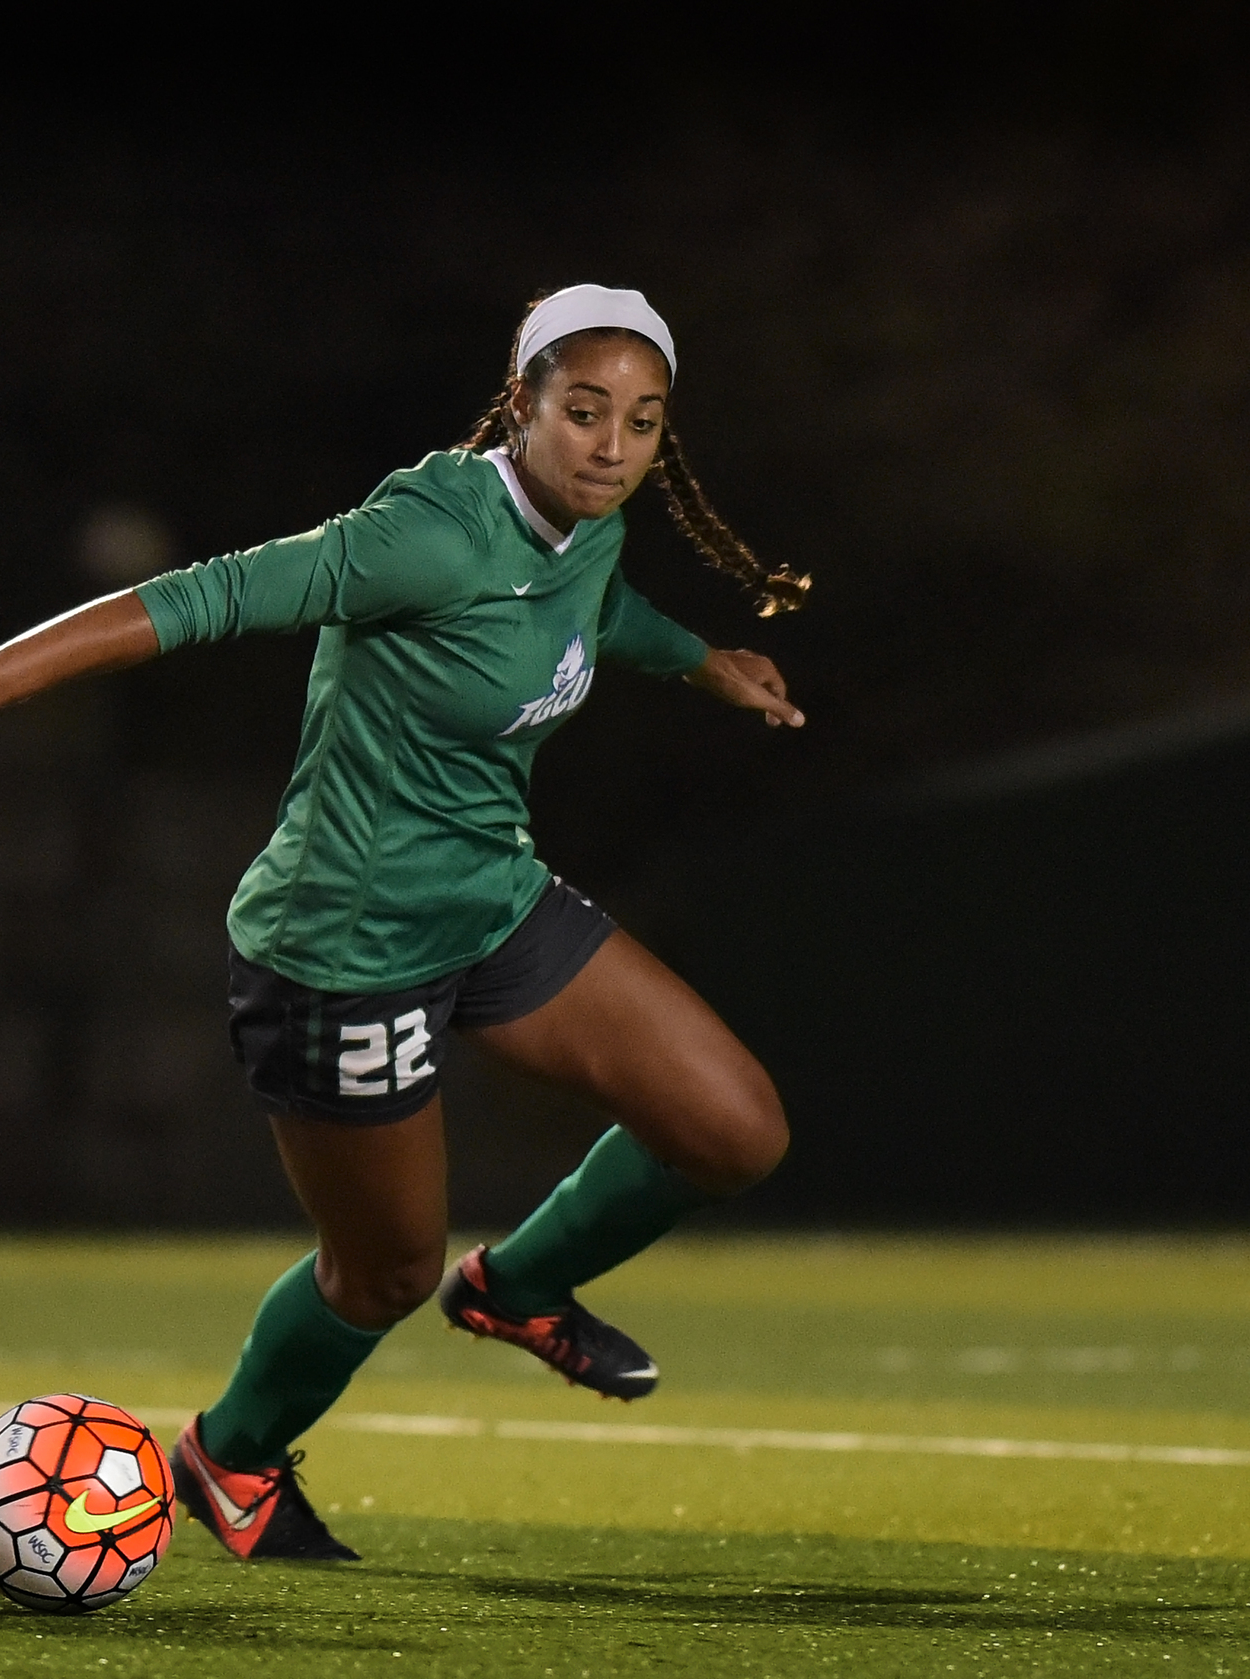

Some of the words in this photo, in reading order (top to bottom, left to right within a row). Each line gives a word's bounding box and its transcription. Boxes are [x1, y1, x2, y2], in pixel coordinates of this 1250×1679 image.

[497, 667, 595, 736] FGCU
[338, 1008, 436, 1095] 22
[28, 1535, 54, 1563] WSOC
